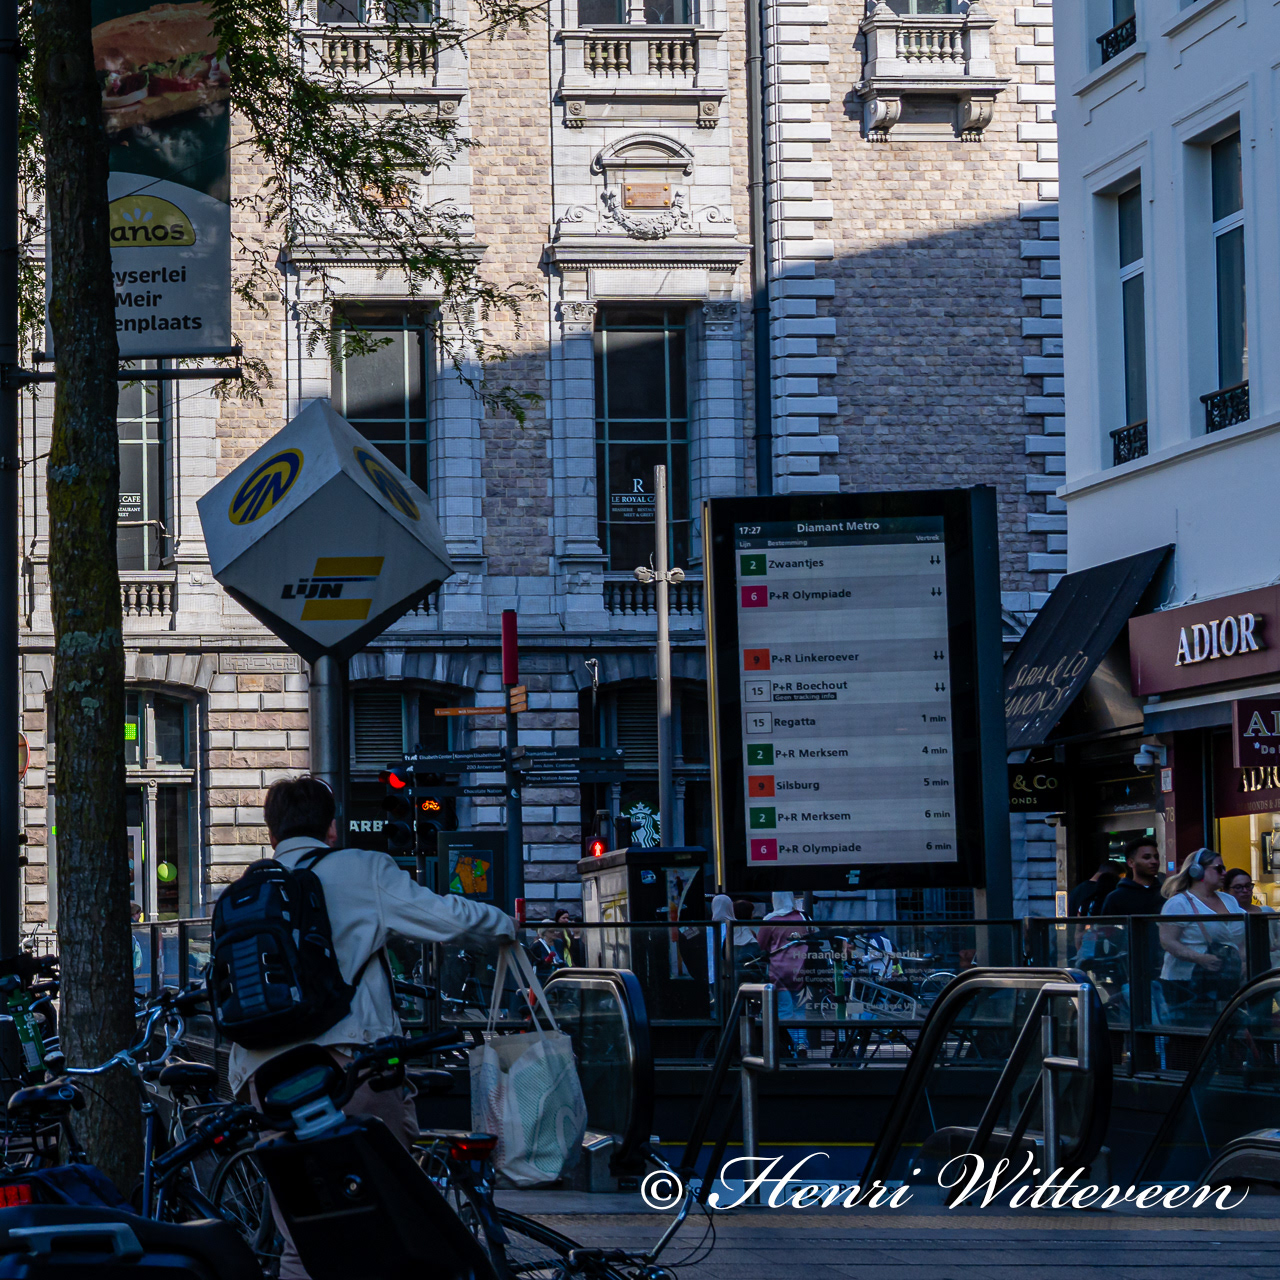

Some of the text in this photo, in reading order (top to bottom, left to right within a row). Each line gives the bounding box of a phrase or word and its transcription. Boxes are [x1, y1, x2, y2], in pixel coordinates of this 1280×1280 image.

[115, 291, 162, 307] Meir
[632, 478, 644, 492] R
[739, 522, 880, 535] 17:27 Diamant Metro
[767, 539, 808, 547] Bestemming
[916, 534, 940, 542] Vertrek
[750, 558, 824, 570] 2 Zwaantjes
[751, 589, 852, 601] 6 P+R Olympiade
[1174, 613, 1259, 667] ADIOR
[753, 653, 859, 665] 9 P+R Linkeroever
[751, 681, 848, 696] 15 P+R Boechout
[792, 693, 820, 701] tracking
[753, 719, 765, 727] 15
[774, 718, 816, 728] Regatta
[921, 714, 927, 722] 1
[757, 750, 763, 759] 2
[776, 750, 795, 758] P+R
[798, 748, 849, 758] Merksem
[922, 746, 929, 754] 4
[758, 782, 765, 791] 9
[776, 781, 820, 792] Silsburg
[924, 778, 930, 786] 5
[1010, 796, 1038, 805] ONDS
[759, 810, 951, 822] 2 P+R Merksem 6 min
[1165, 806, 1175, 822] 78
[760, 842, 952, 854] 6 P+R Olympiade 6 min
[792, 951, 848, 961] Heraanleg
